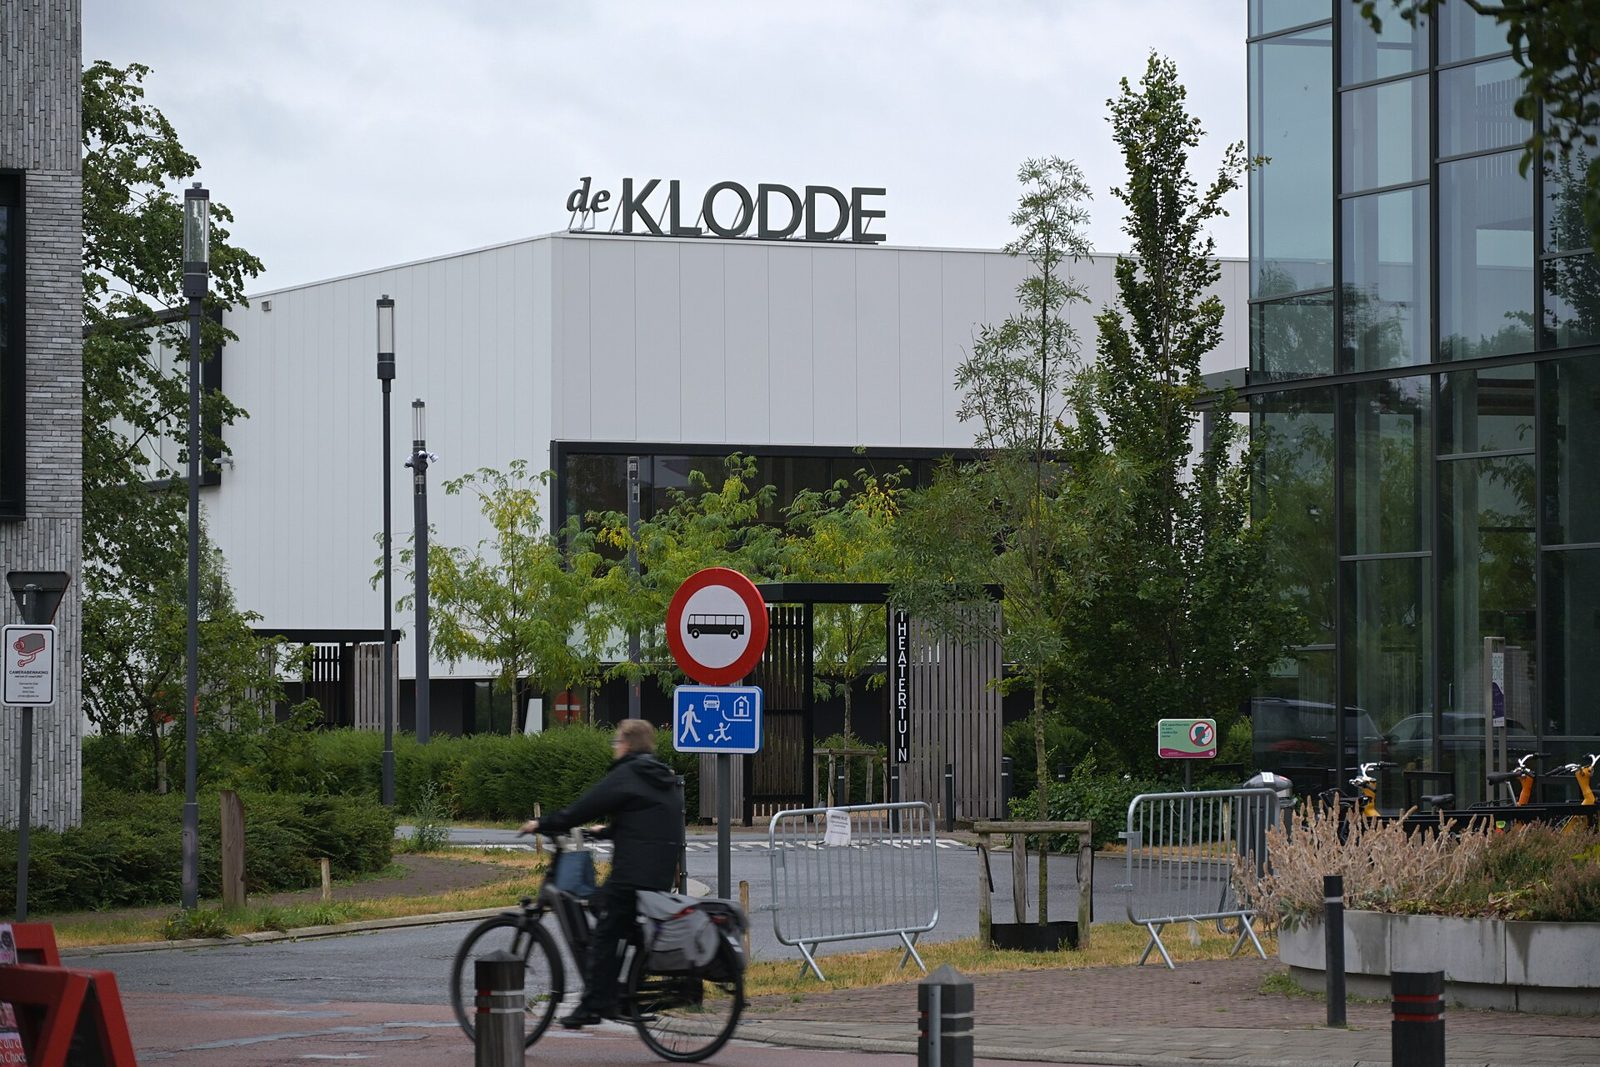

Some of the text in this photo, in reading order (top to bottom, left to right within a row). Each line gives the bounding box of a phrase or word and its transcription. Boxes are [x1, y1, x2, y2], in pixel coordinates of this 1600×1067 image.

[566, 176, 887, 242] de KLODDE
[897, 608, 908, 762] THEATERTUIN
